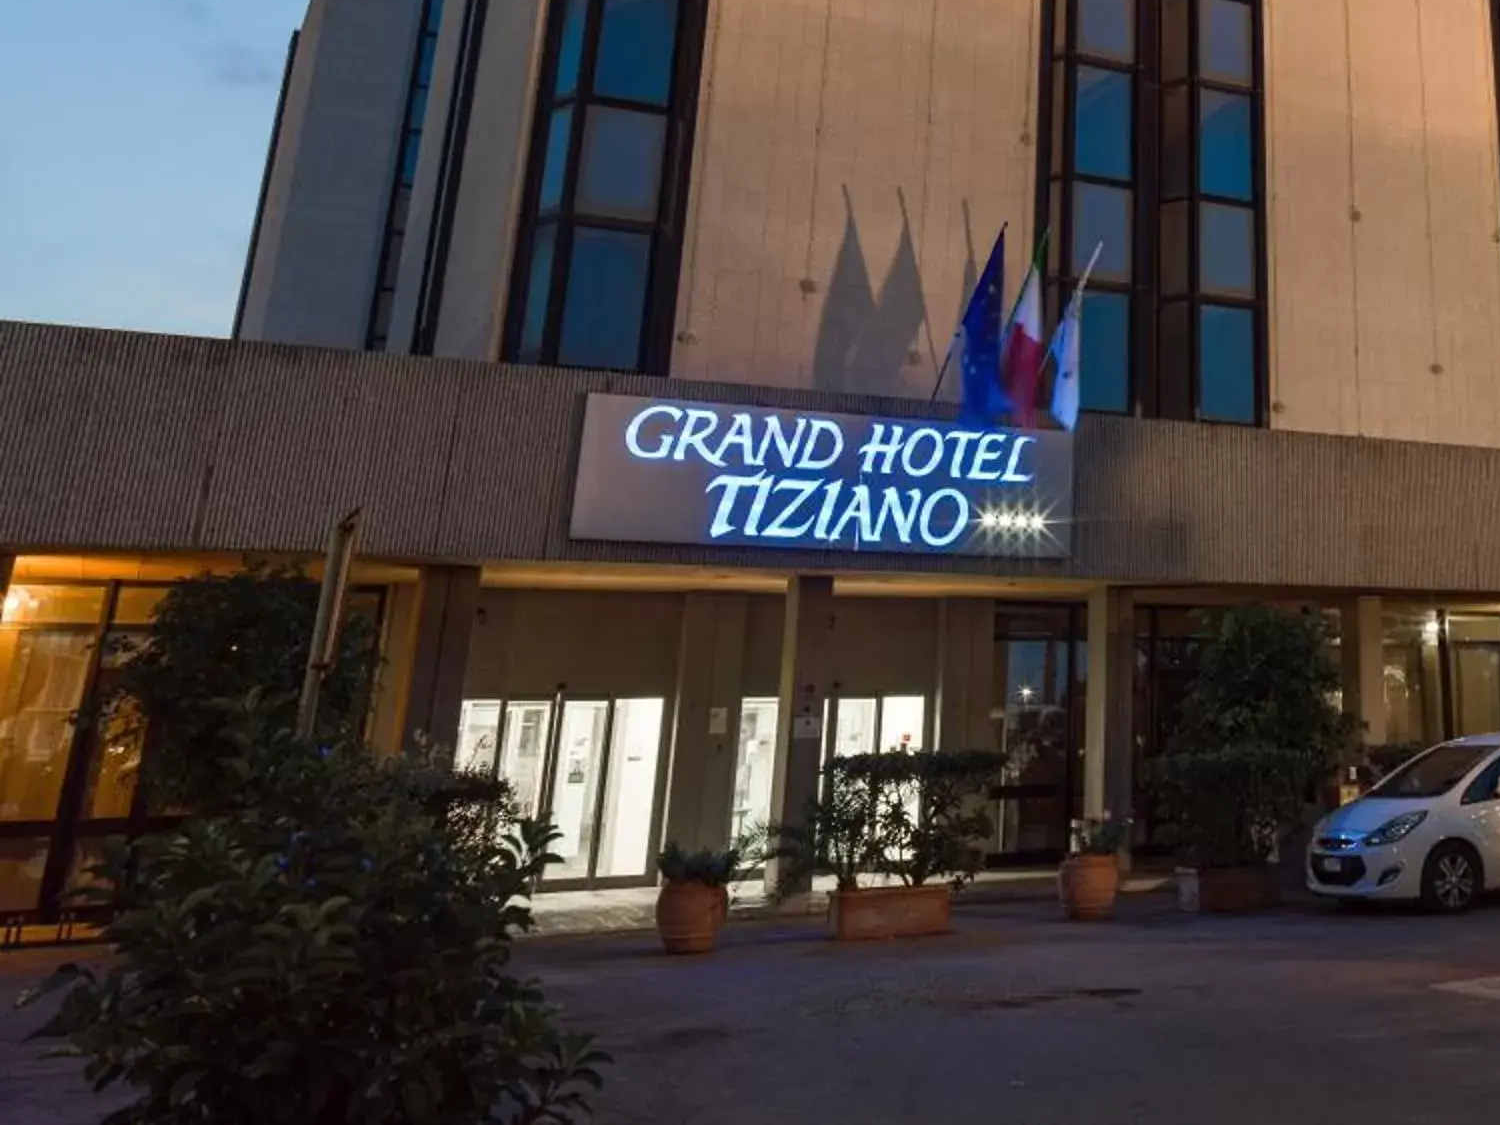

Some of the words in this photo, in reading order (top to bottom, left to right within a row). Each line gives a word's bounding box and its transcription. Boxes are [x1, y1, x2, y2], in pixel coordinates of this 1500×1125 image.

[625, 405, 844, 469] GRAND
[858, 424, 1036, 482] HOTEL
[705, 469, 969, 545] TIZIANO
